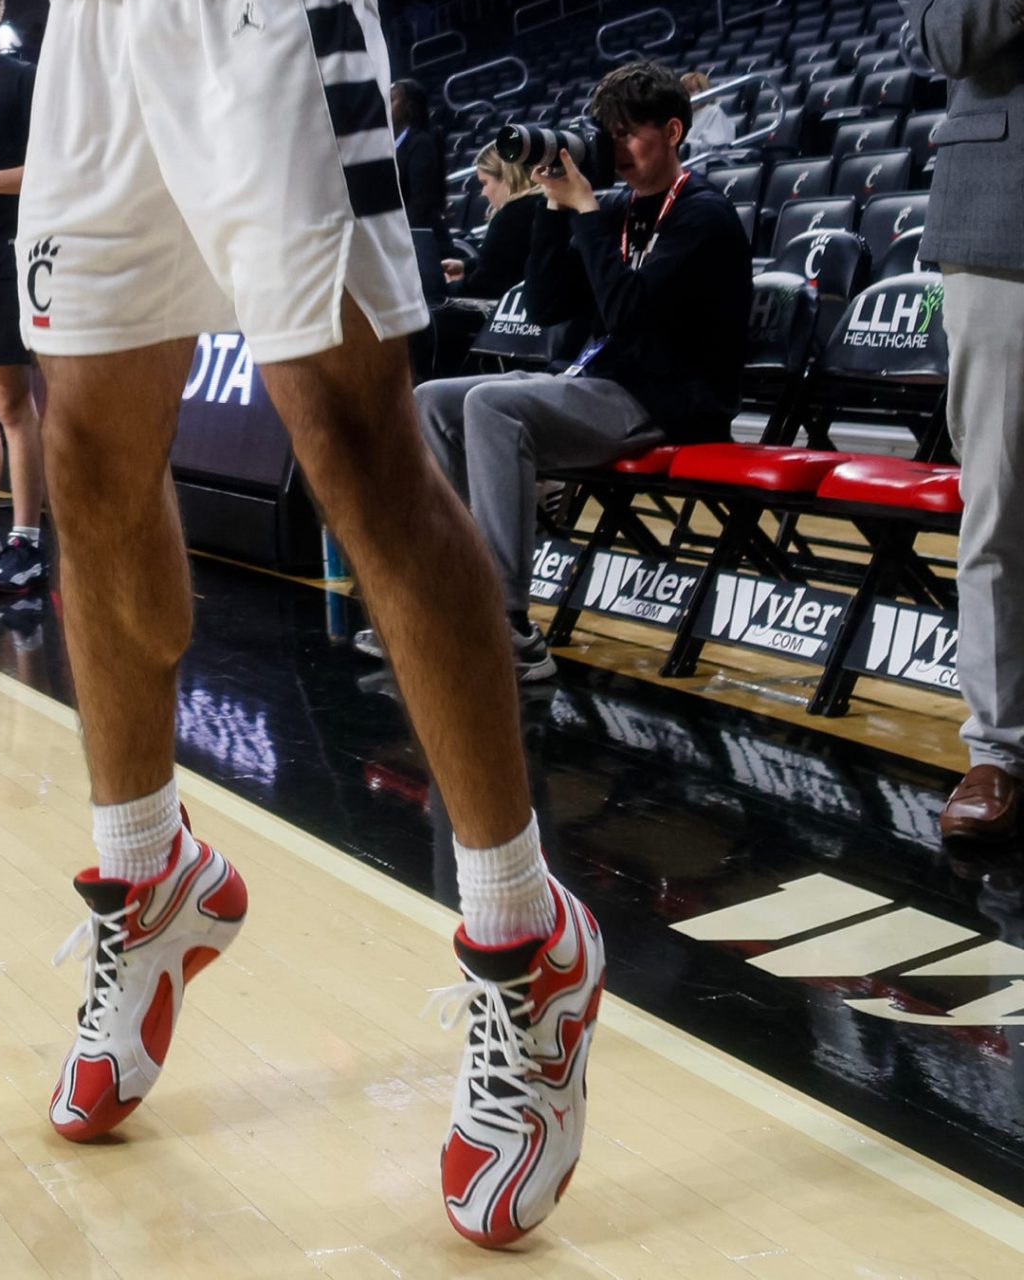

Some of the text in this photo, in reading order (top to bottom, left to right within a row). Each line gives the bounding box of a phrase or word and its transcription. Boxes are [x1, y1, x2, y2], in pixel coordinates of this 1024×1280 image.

[489, 322, 542, 336] HEALTHCARE
[848, 293, 923, 333] LLH
[843, 331, 929, 348] HEALTHCARE
[532, 541, 576, 580] ler
[583, 552, 697, 610] Wyler
[710, 574, 843, 640] Wyler
[768, 632, 805, 652] .COM
